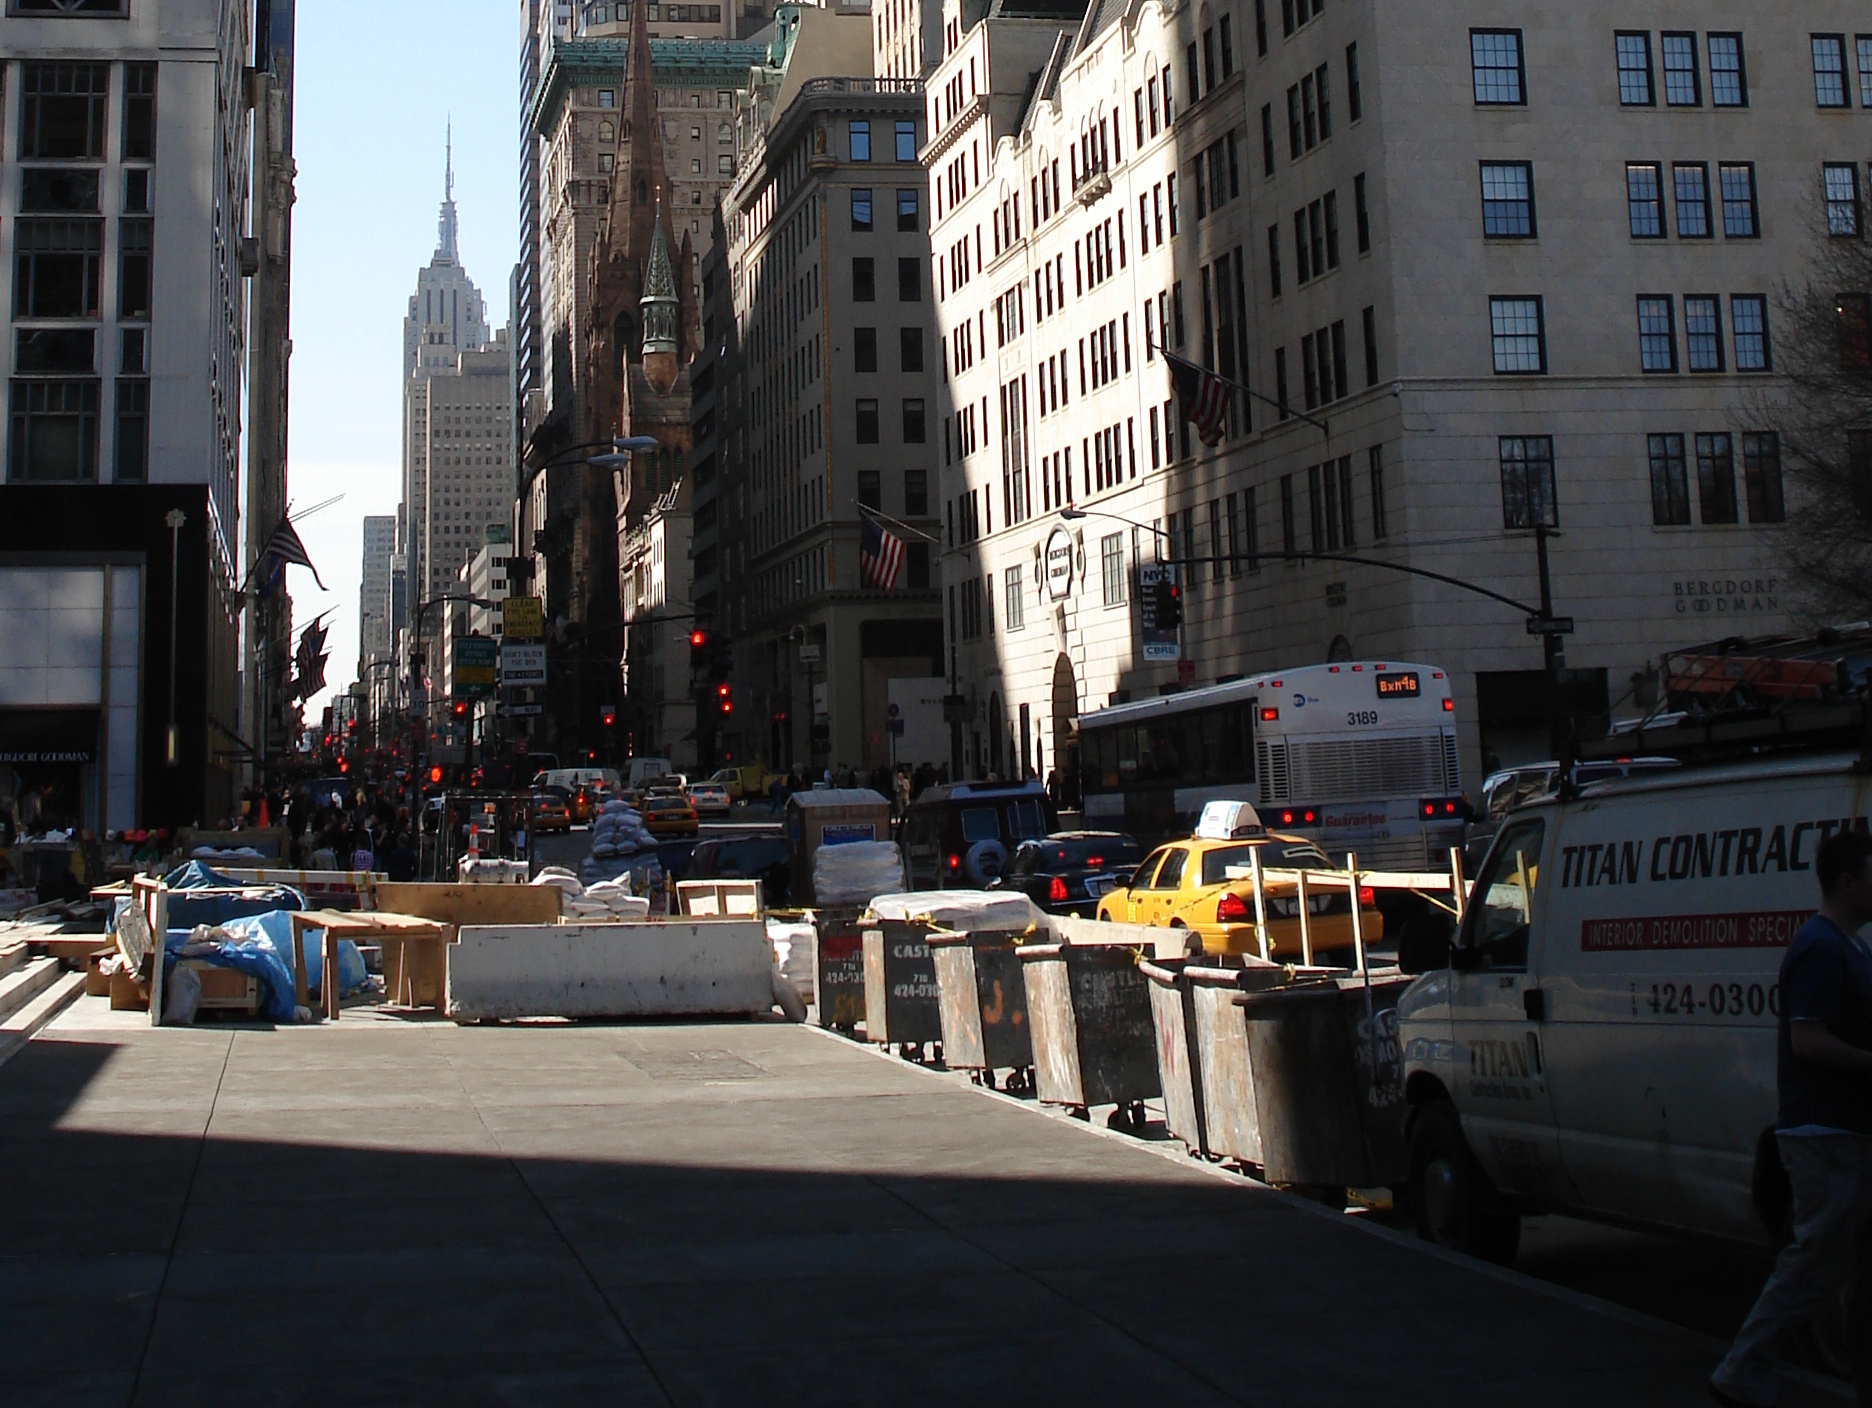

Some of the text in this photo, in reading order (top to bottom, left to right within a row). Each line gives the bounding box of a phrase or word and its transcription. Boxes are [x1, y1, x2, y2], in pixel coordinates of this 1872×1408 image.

[1143, 570, 1173, 581] NYC
[1673, 579, 1778, 596] BERGDORF
[1675, 596, 1778, 613] GOODMAN
[1379, 675, 1417, 693] BxM4B
[410, 700, 425, 709] 30
[1347, 711, 1378, 725] 3189
[1325, 813, 1386, 827] Guarantee
[1562, 840, 1643, 888] TITAN
[1589, 922, 1643, 946] INTERIOR
[1652, 918, 1738, 944] DEMOLITION
[1467, 1039, 1529, 1078] TITAN
